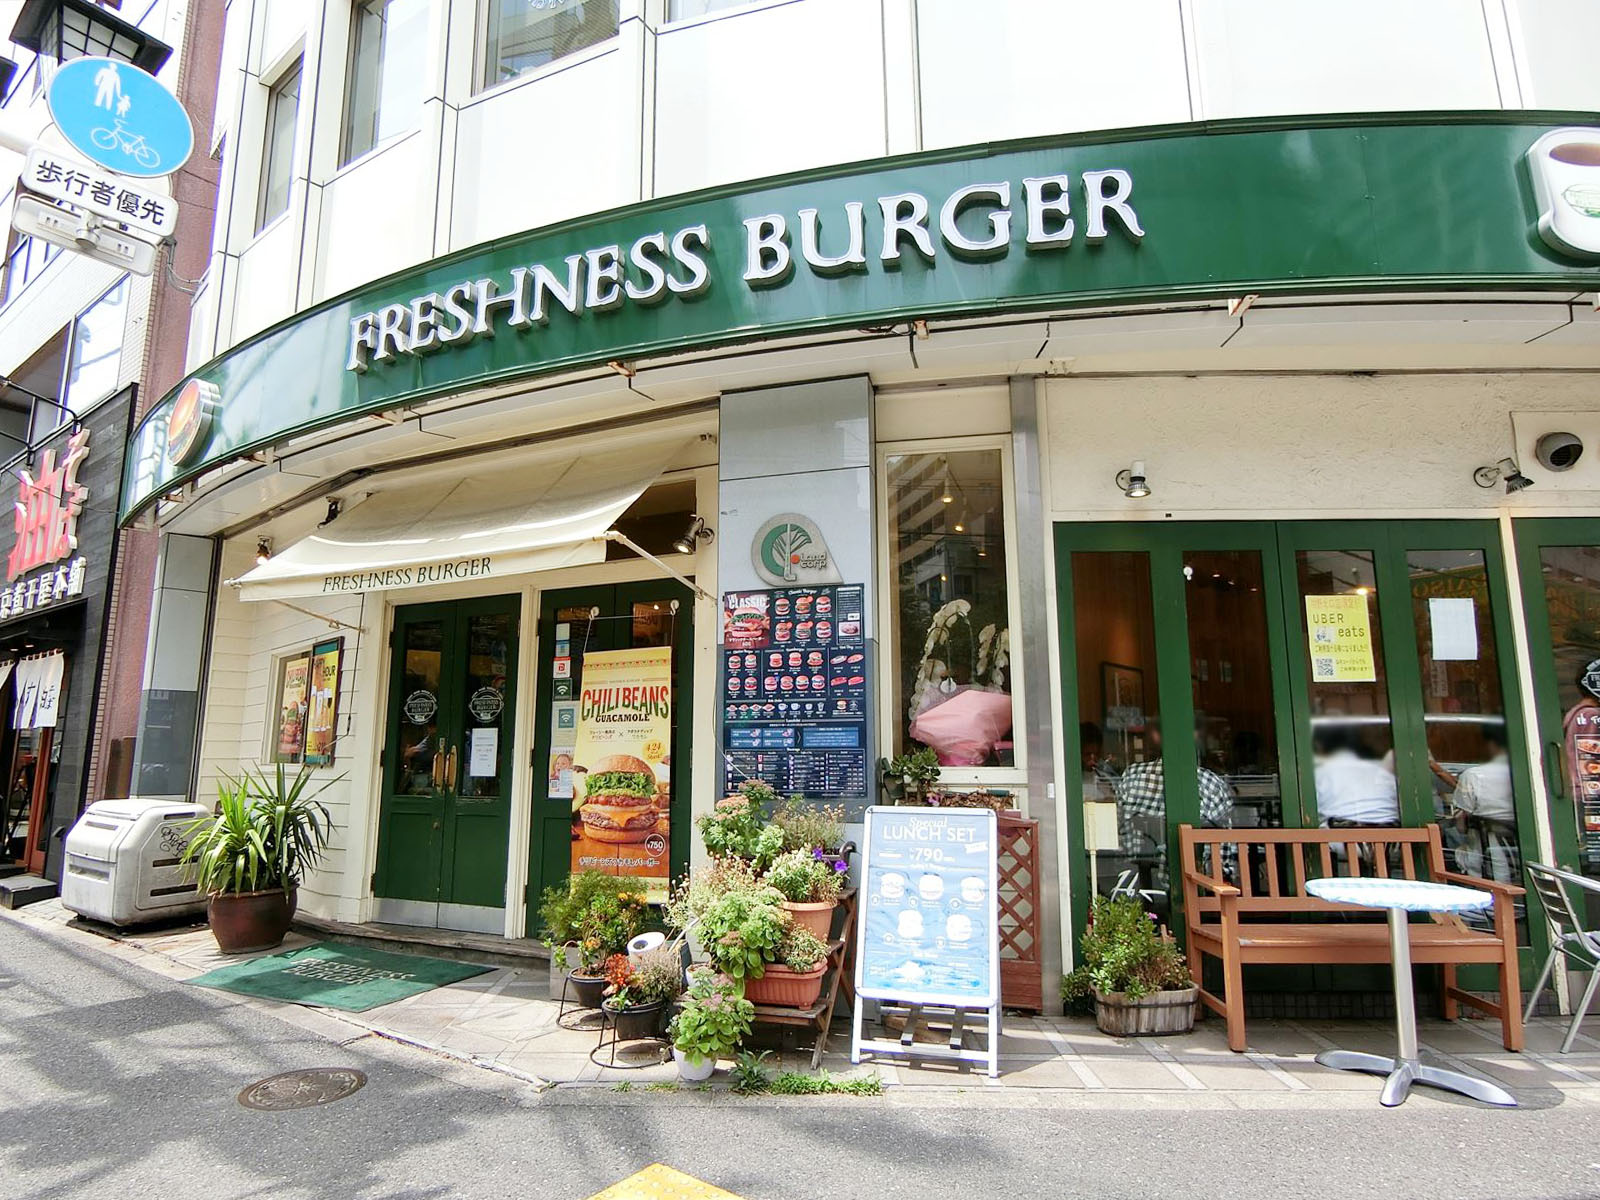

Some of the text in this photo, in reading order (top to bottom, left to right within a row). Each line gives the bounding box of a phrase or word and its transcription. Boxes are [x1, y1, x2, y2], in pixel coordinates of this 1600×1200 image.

[36, 160, 165, 226] 歩行者優先
[346, 169, 1145, 374] FRESHNESS BURGER
[323, 557, 491, 593] FRESHNESS BURGER
[1313, 613, 1344, 624] UBER
[1338, 626, 1365, 638] eats
[581, 685, 669, 721] CHILI BEANS
[595, 713, 650, 723] GUACAMOLE
[909, 816, 948, 828] Special
[884, 825, 977, 842] LUNCH SET
